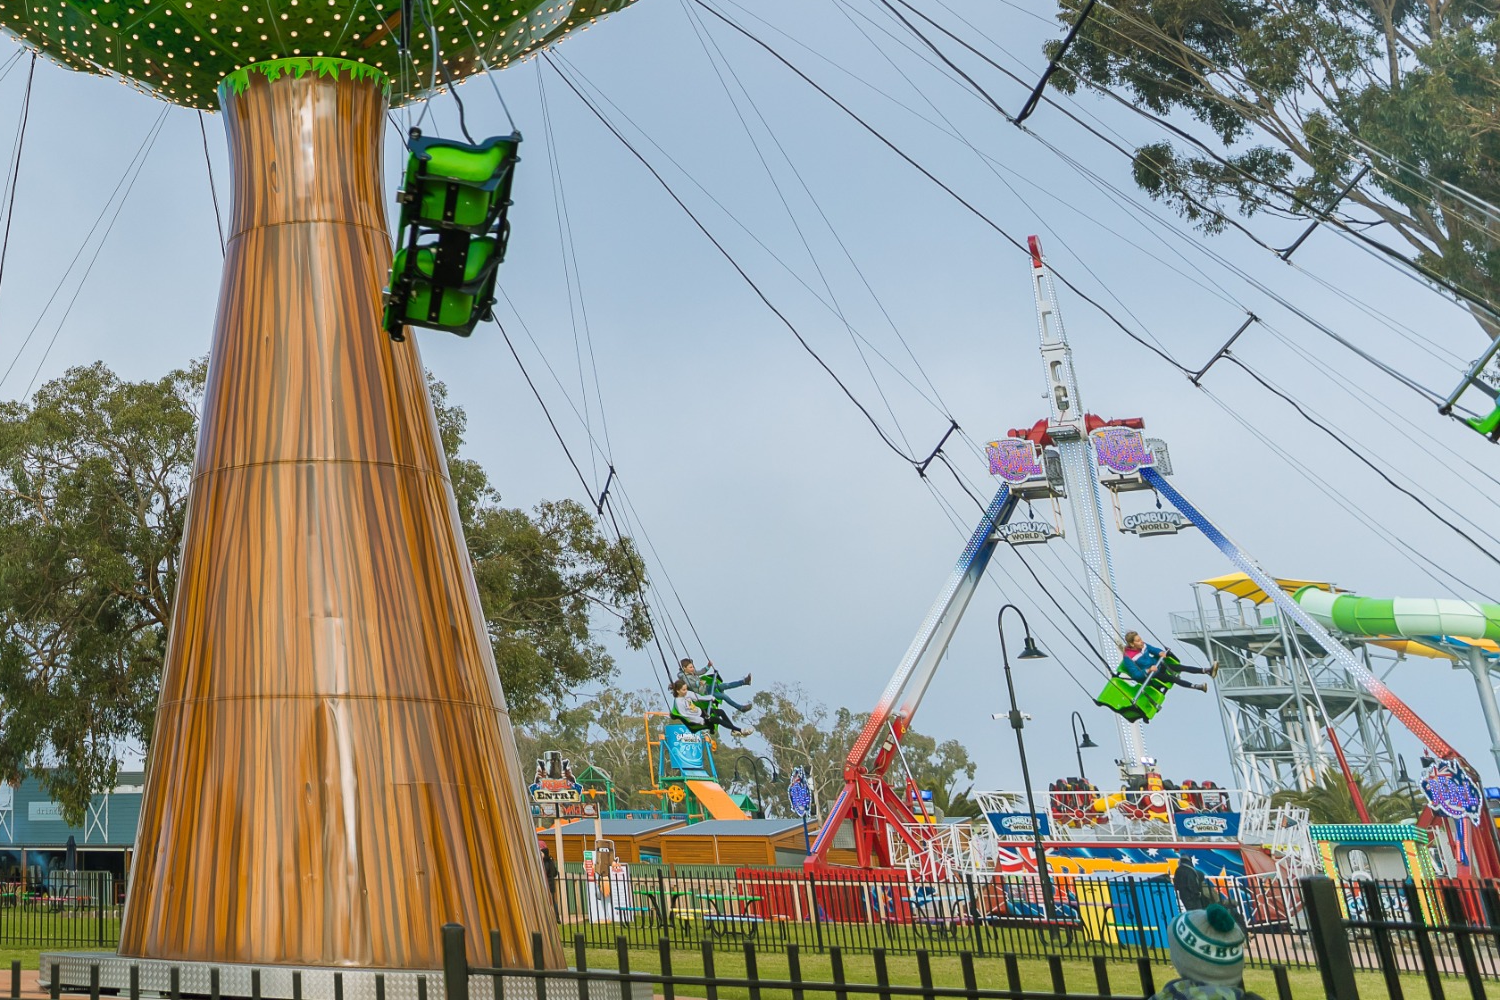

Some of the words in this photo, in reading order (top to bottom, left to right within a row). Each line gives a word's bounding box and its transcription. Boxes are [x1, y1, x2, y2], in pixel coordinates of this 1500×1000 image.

[1124, 511, 1180, 529] GUMBUYA
[997, 522, 1050, 538] GUMBUYA
[1140, 523, 1170, 531] WORLD
[537, 791, 575, 800] ENTRY
